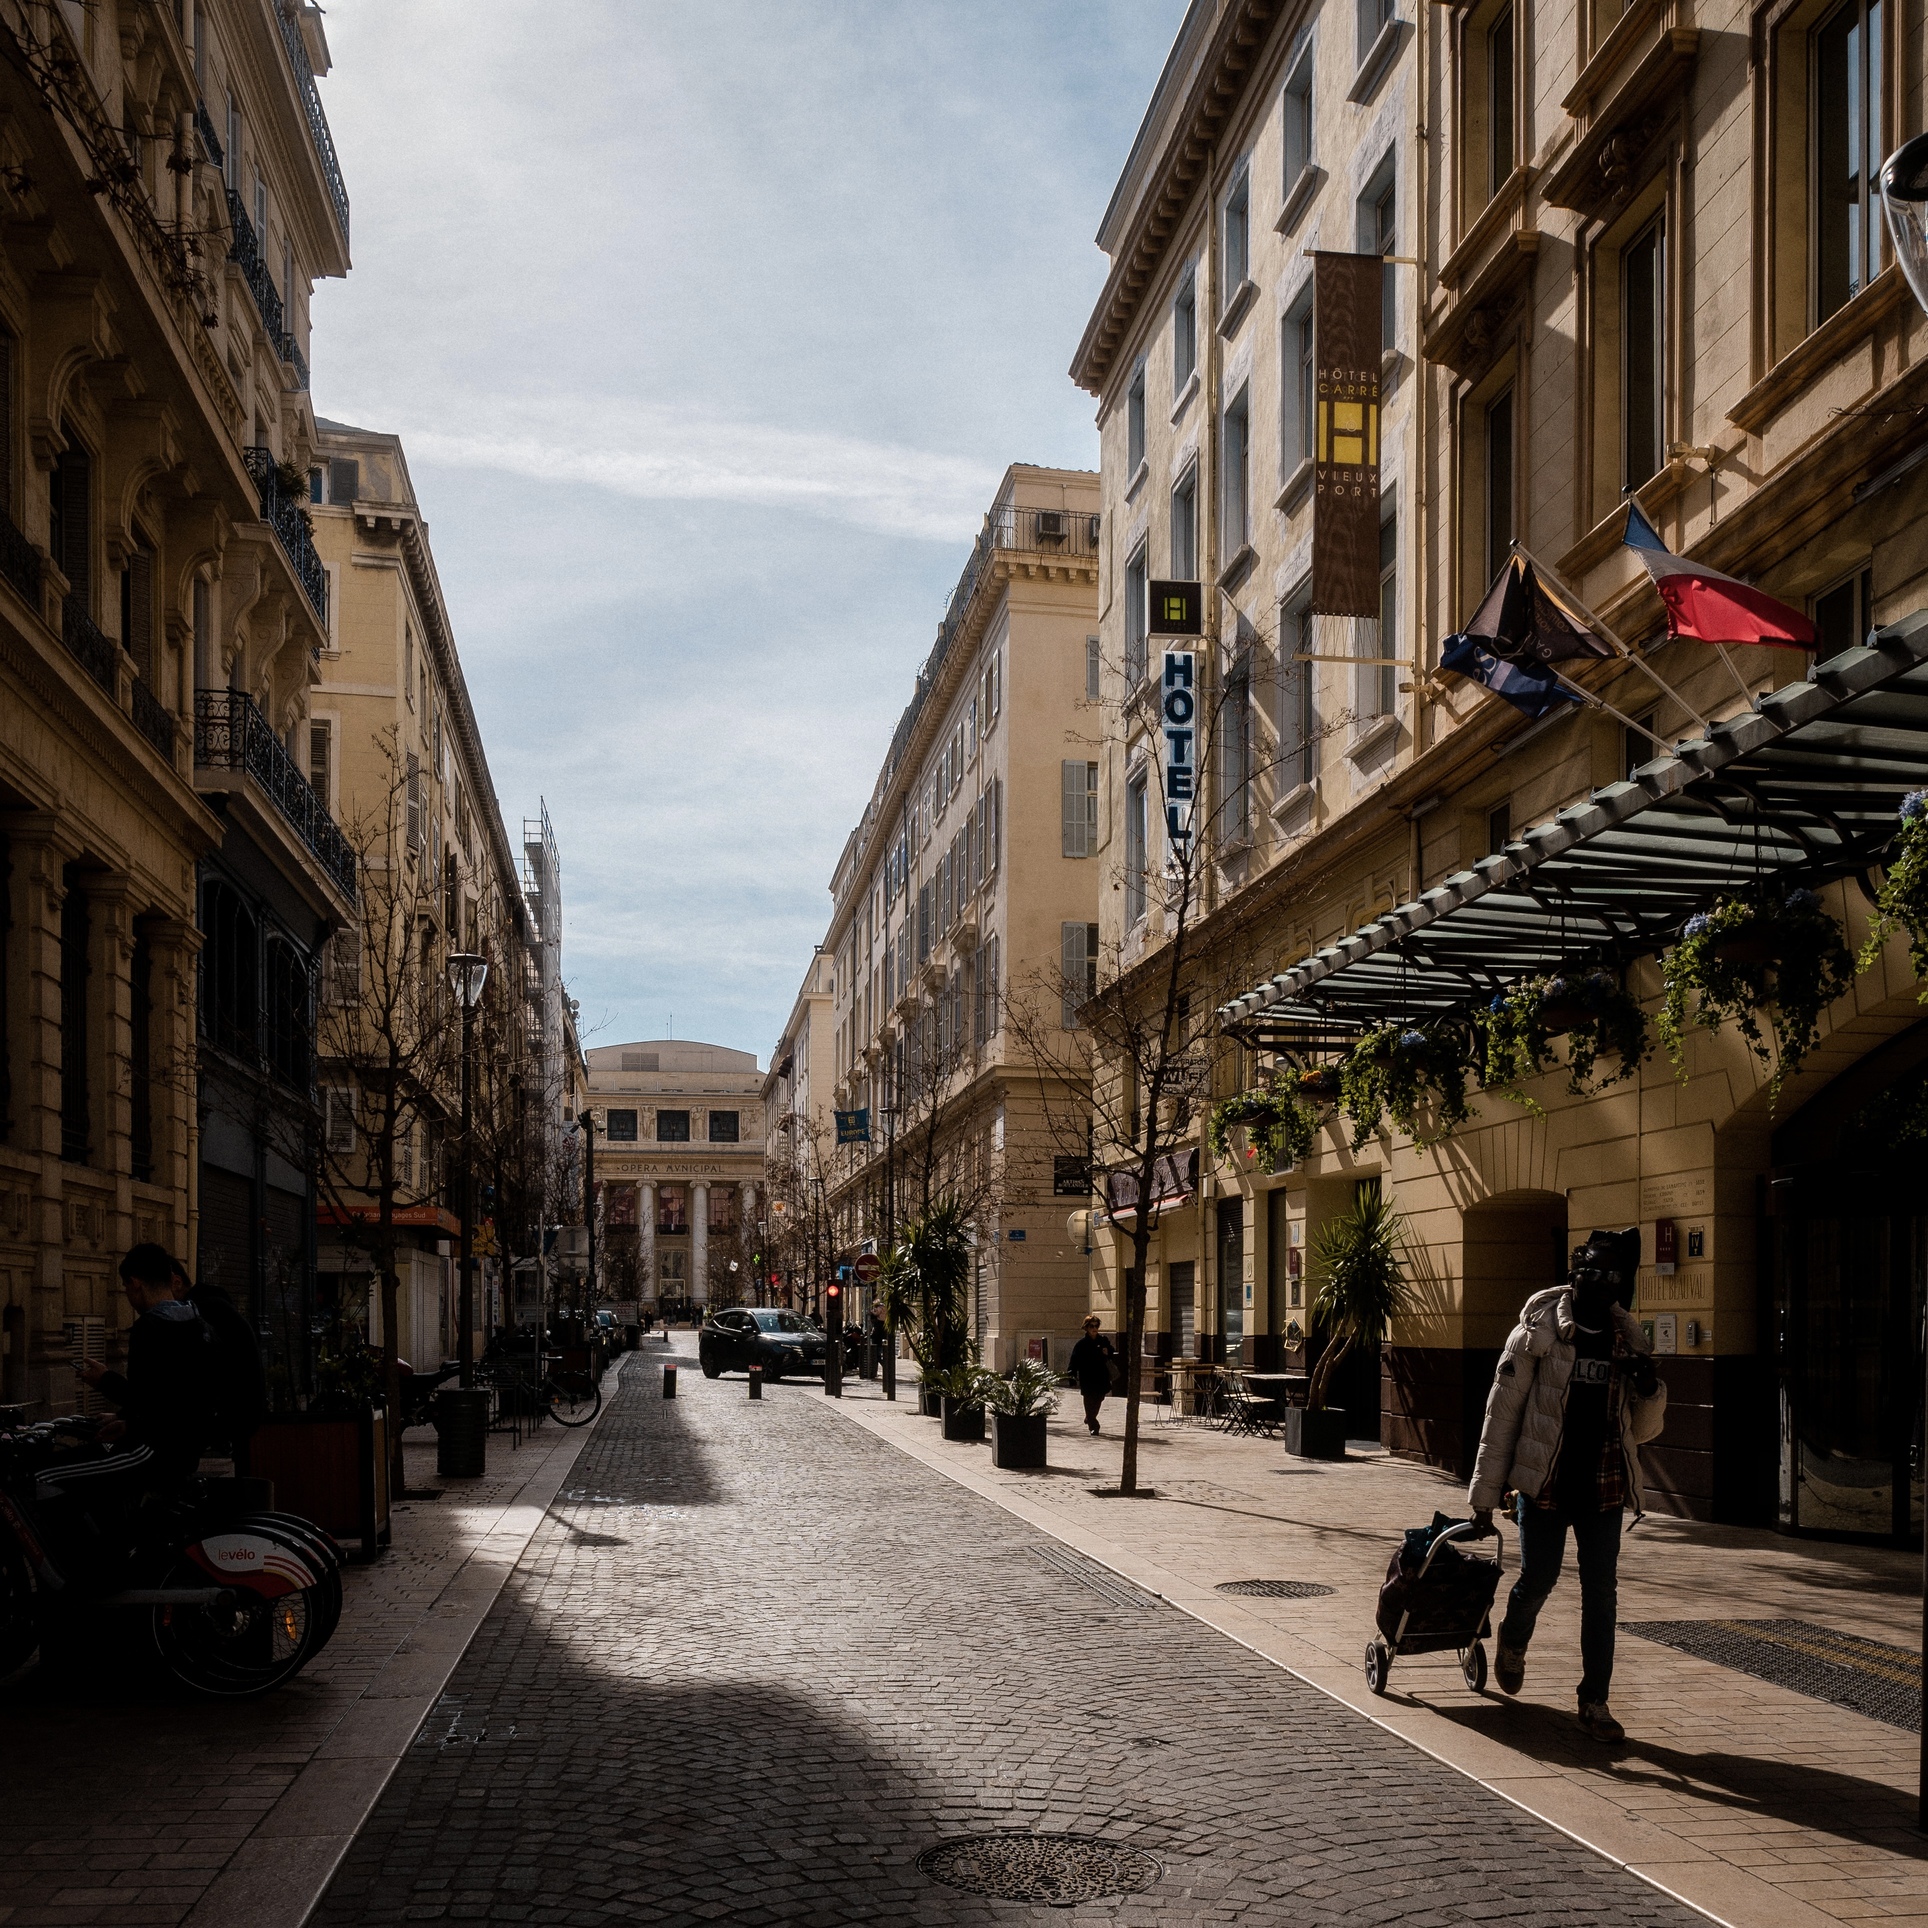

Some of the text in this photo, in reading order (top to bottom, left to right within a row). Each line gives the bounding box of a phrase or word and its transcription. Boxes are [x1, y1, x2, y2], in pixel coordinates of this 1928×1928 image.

[1318, 367, 1378, 383] HÔTEL
[1318, 383, 1378, 397] CARRÉ
[1318, 470, 1377, 484] VIEUX
[1318, 484, 1377, 498] PORT
[1165, 653, 1194, 839] HOTEL
[621, 1164, 659, 1173] OPERA
[413, 1211, 426, 1219] Sud
[1664, 1226, 1672, 1243] H
[1642, 1273, 1706, 1301] HOTEL BEAUVAU
[218, 1548, 256, 1561] levélo
